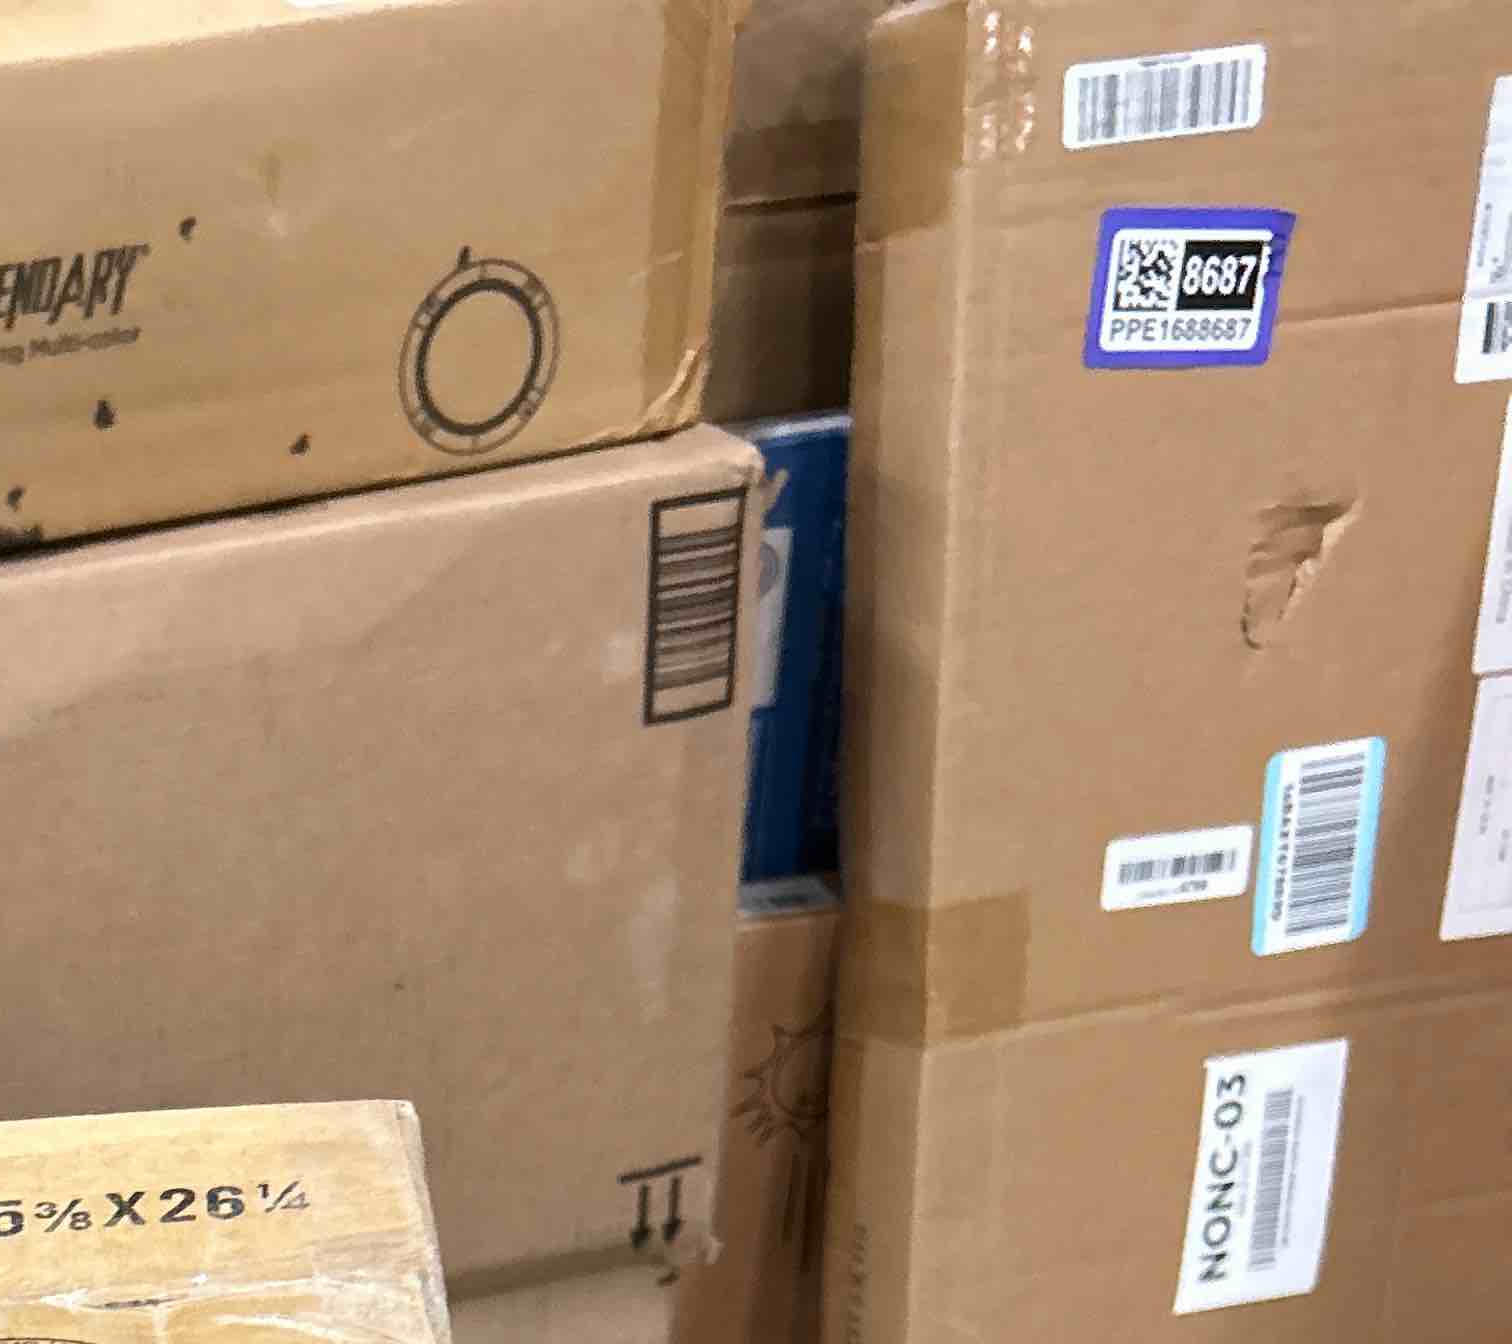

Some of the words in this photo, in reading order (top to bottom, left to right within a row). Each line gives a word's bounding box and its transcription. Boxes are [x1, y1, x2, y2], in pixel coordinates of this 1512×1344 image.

[1182, 255, 1257, 295] 8687
[1110, 318, 1251, 342] PPE1688687
[1197, 1073, 1247, 1284] NONC-03
